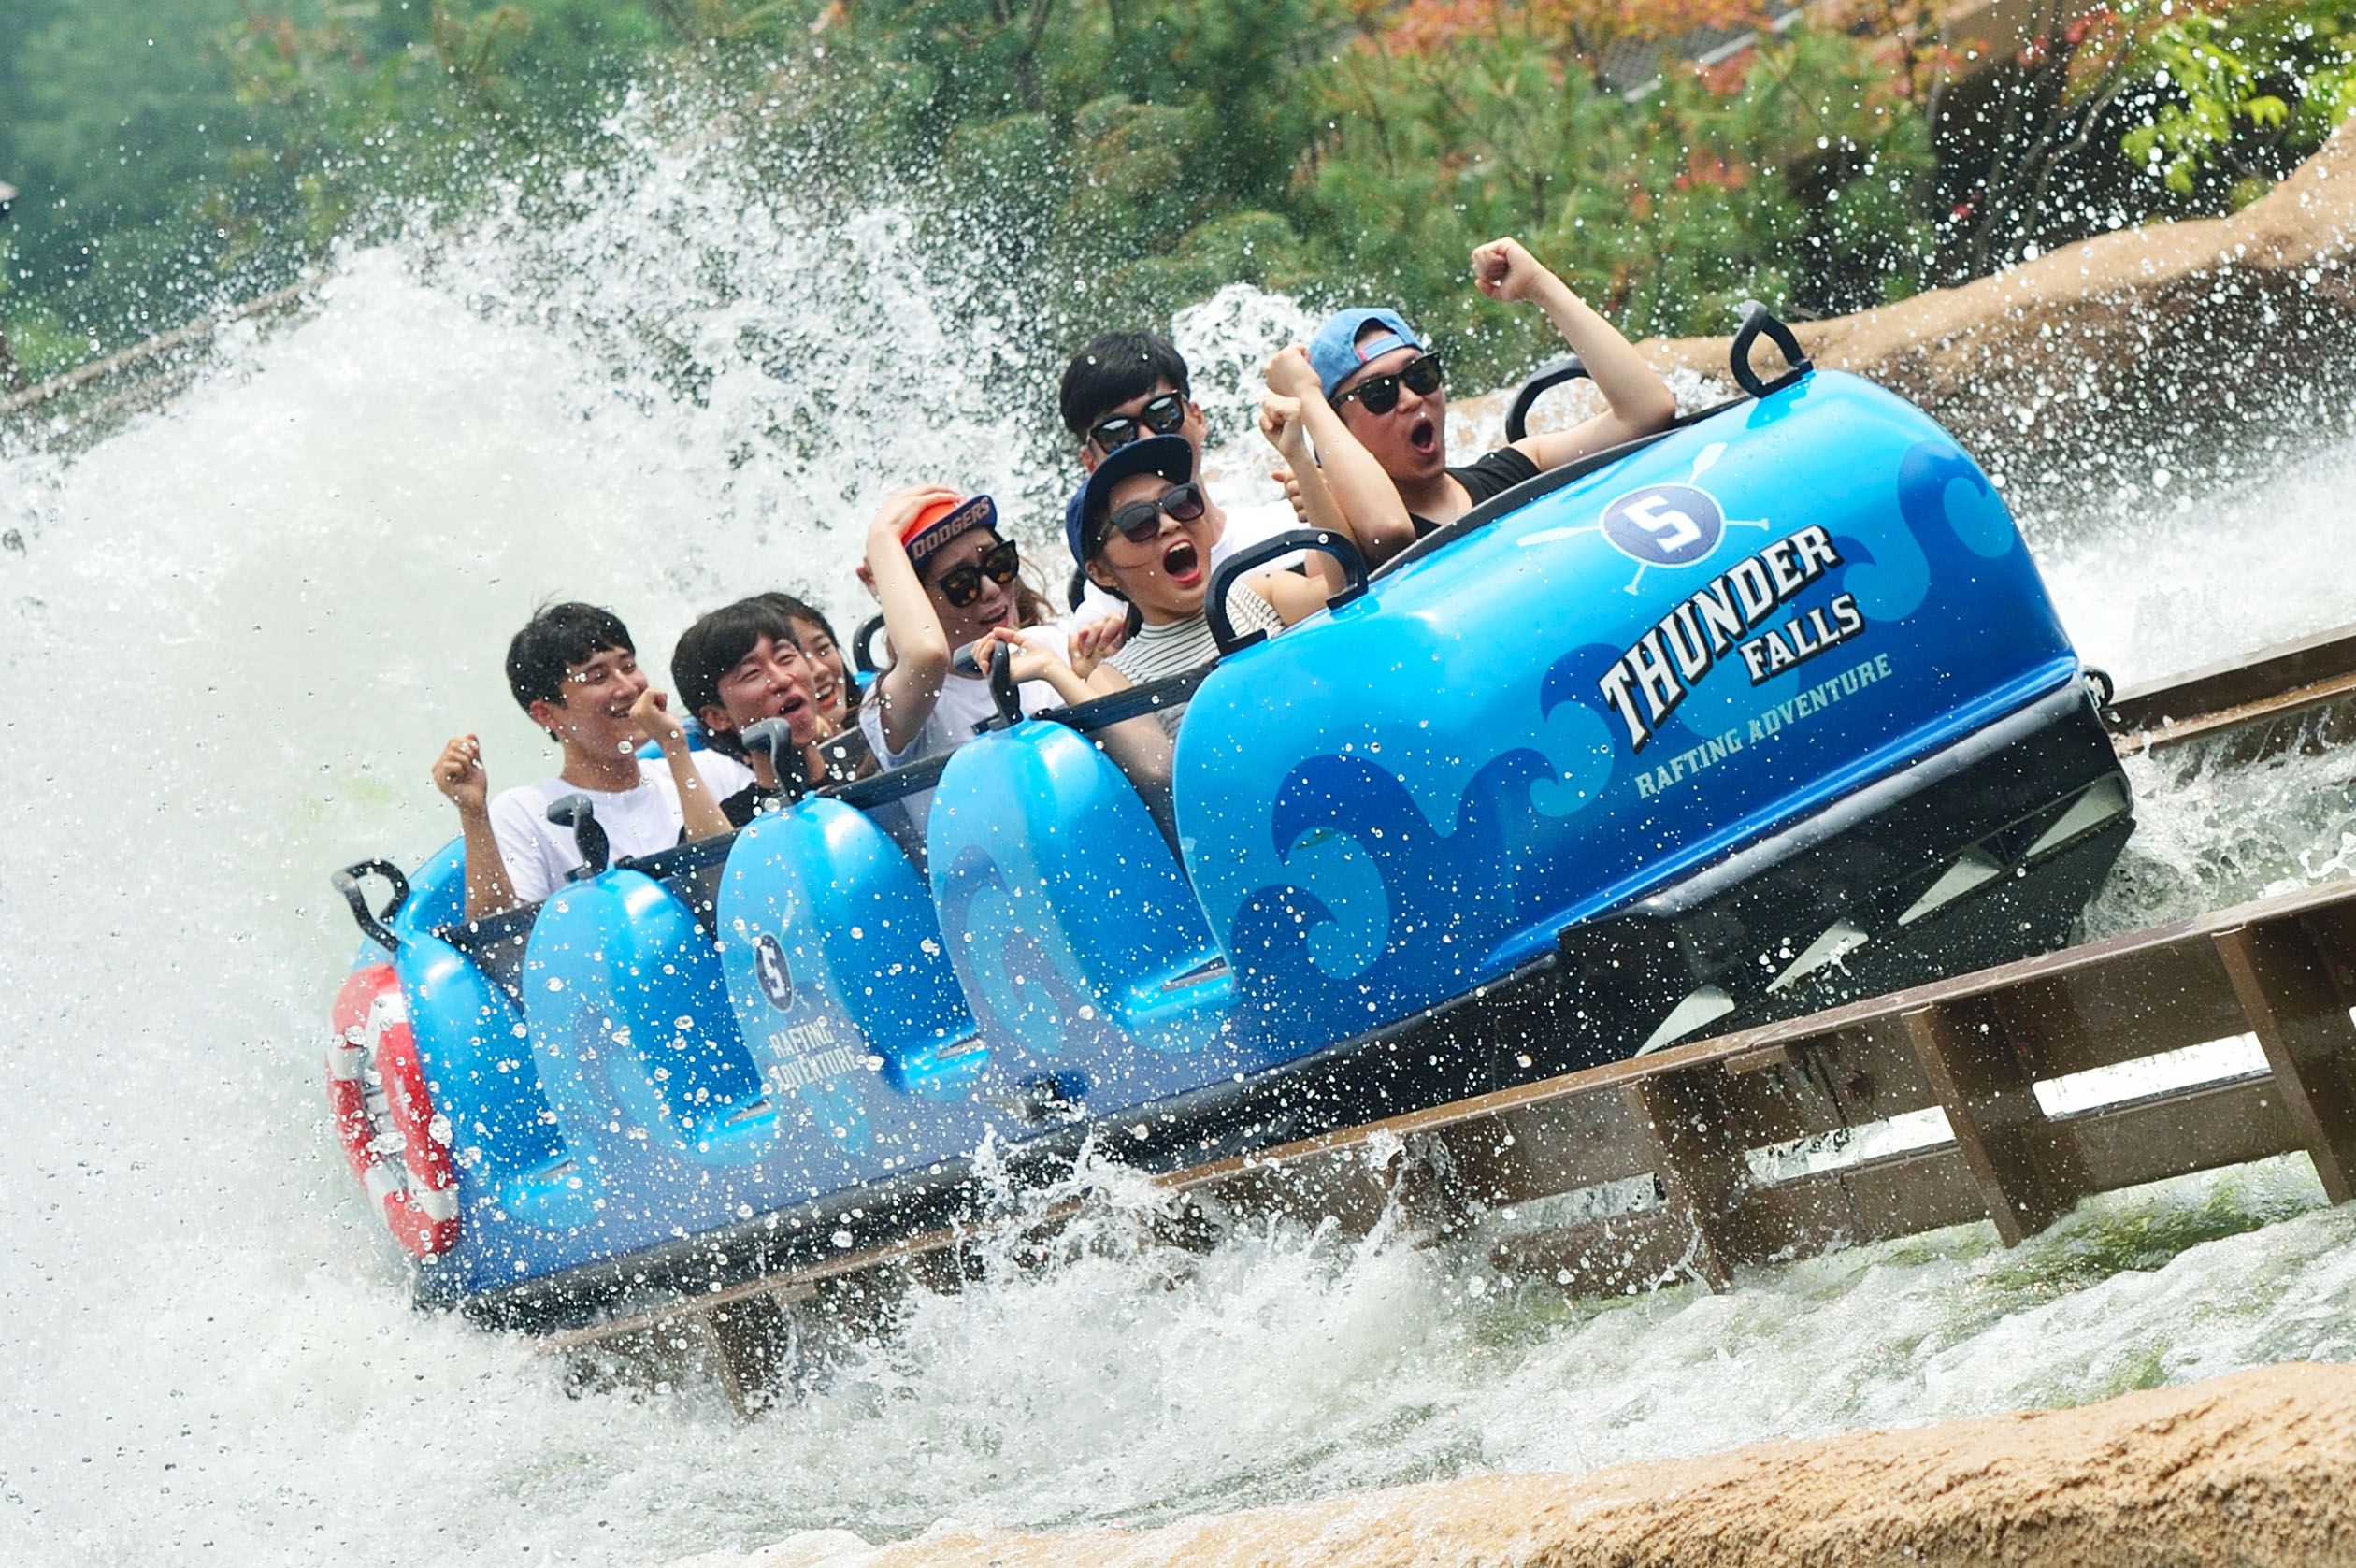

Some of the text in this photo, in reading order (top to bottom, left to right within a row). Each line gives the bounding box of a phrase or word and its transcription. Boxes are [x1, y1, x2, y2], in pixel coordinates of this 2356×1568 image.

[911, 496, 991, 560] DODGERS
[1620, 493, 1702, 554] 5
[1598, 524, 1842, 753] THUNDER
[1738, 593, 1865, 686] FALLS
[1634, 653, 1893, 800] RAFTING ADVENTURE
[760, 945, 786, 999] 5
[769, 1021, 835, 1058] RAFTING
